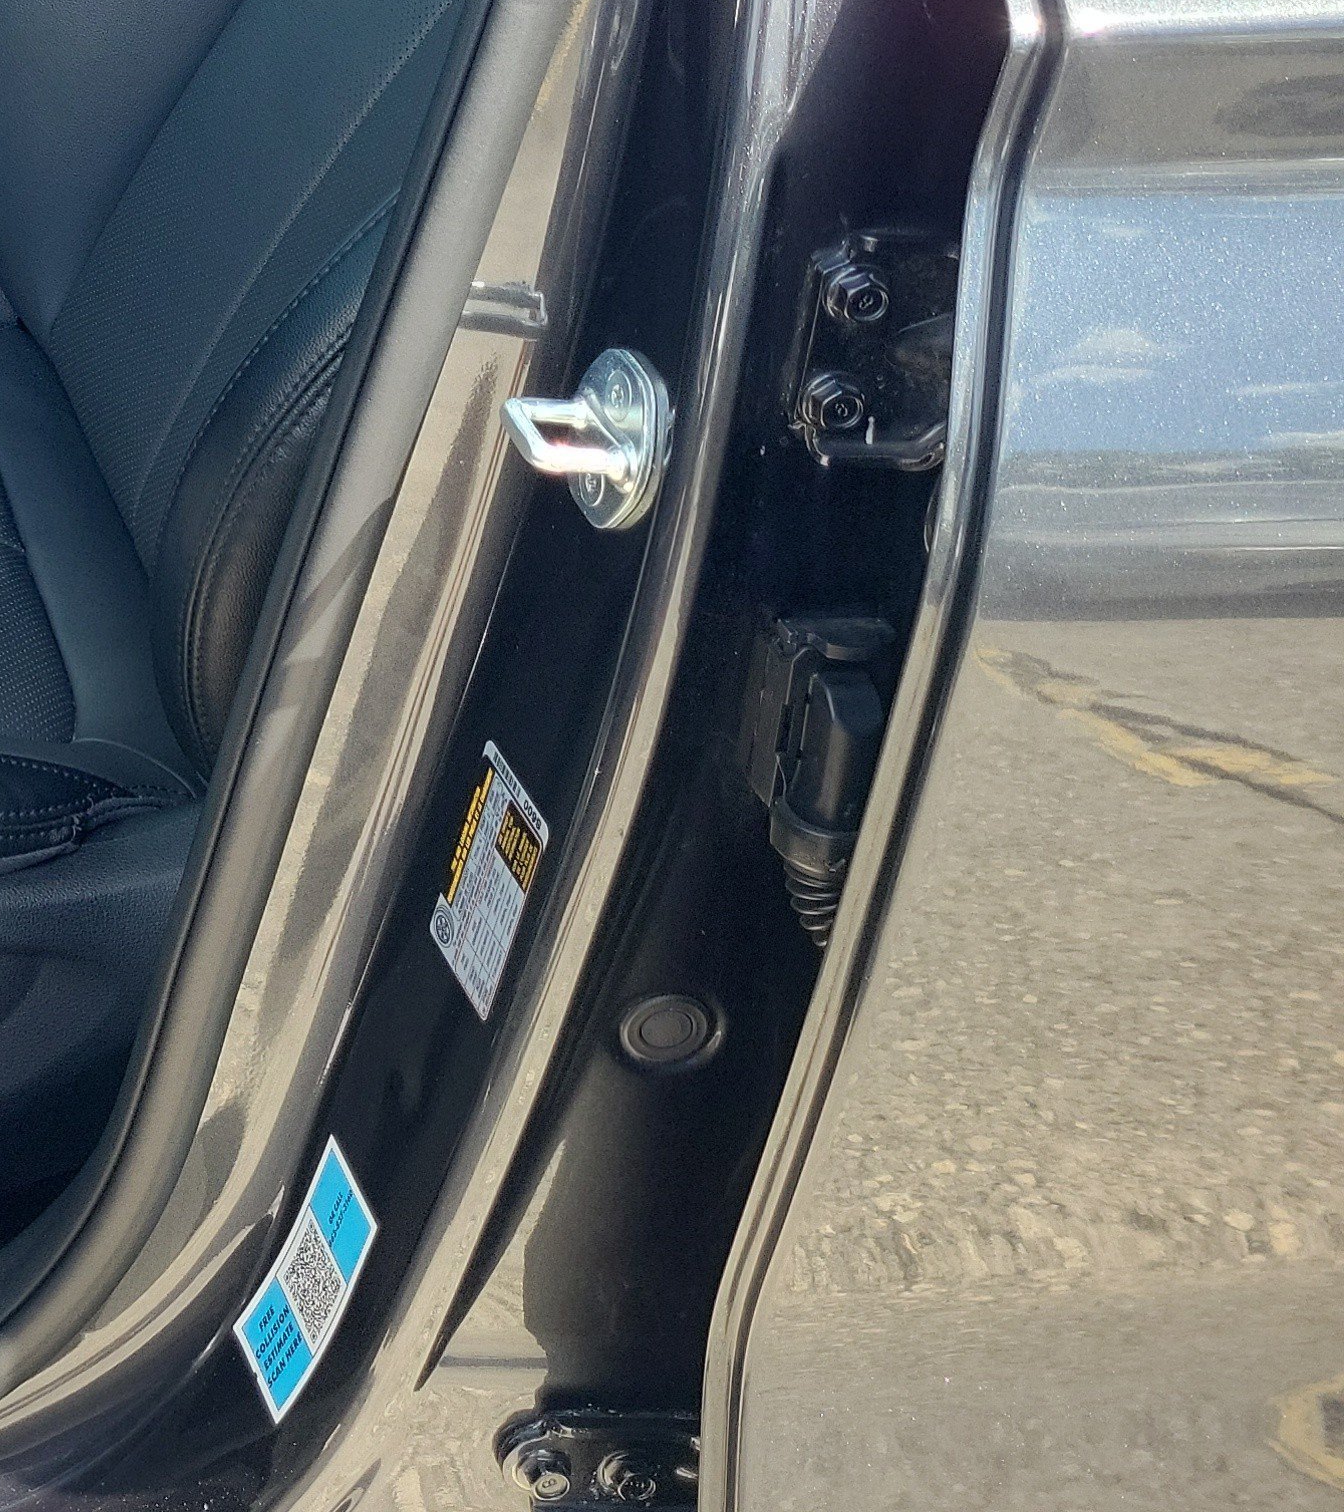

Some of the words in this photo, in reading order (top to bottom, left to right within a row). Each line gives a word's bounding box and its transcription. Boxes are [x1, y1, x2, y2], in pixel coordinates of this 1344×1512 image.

[255, 1304, 290, 1360] COLLISION
[258, 1305, 275, 1333] FREE
[263, 1321, 294, 1371] ESTIMATE
[267, 1357, 287, 1389] SCAN
[285, 1331, 303, 1361] HERE
